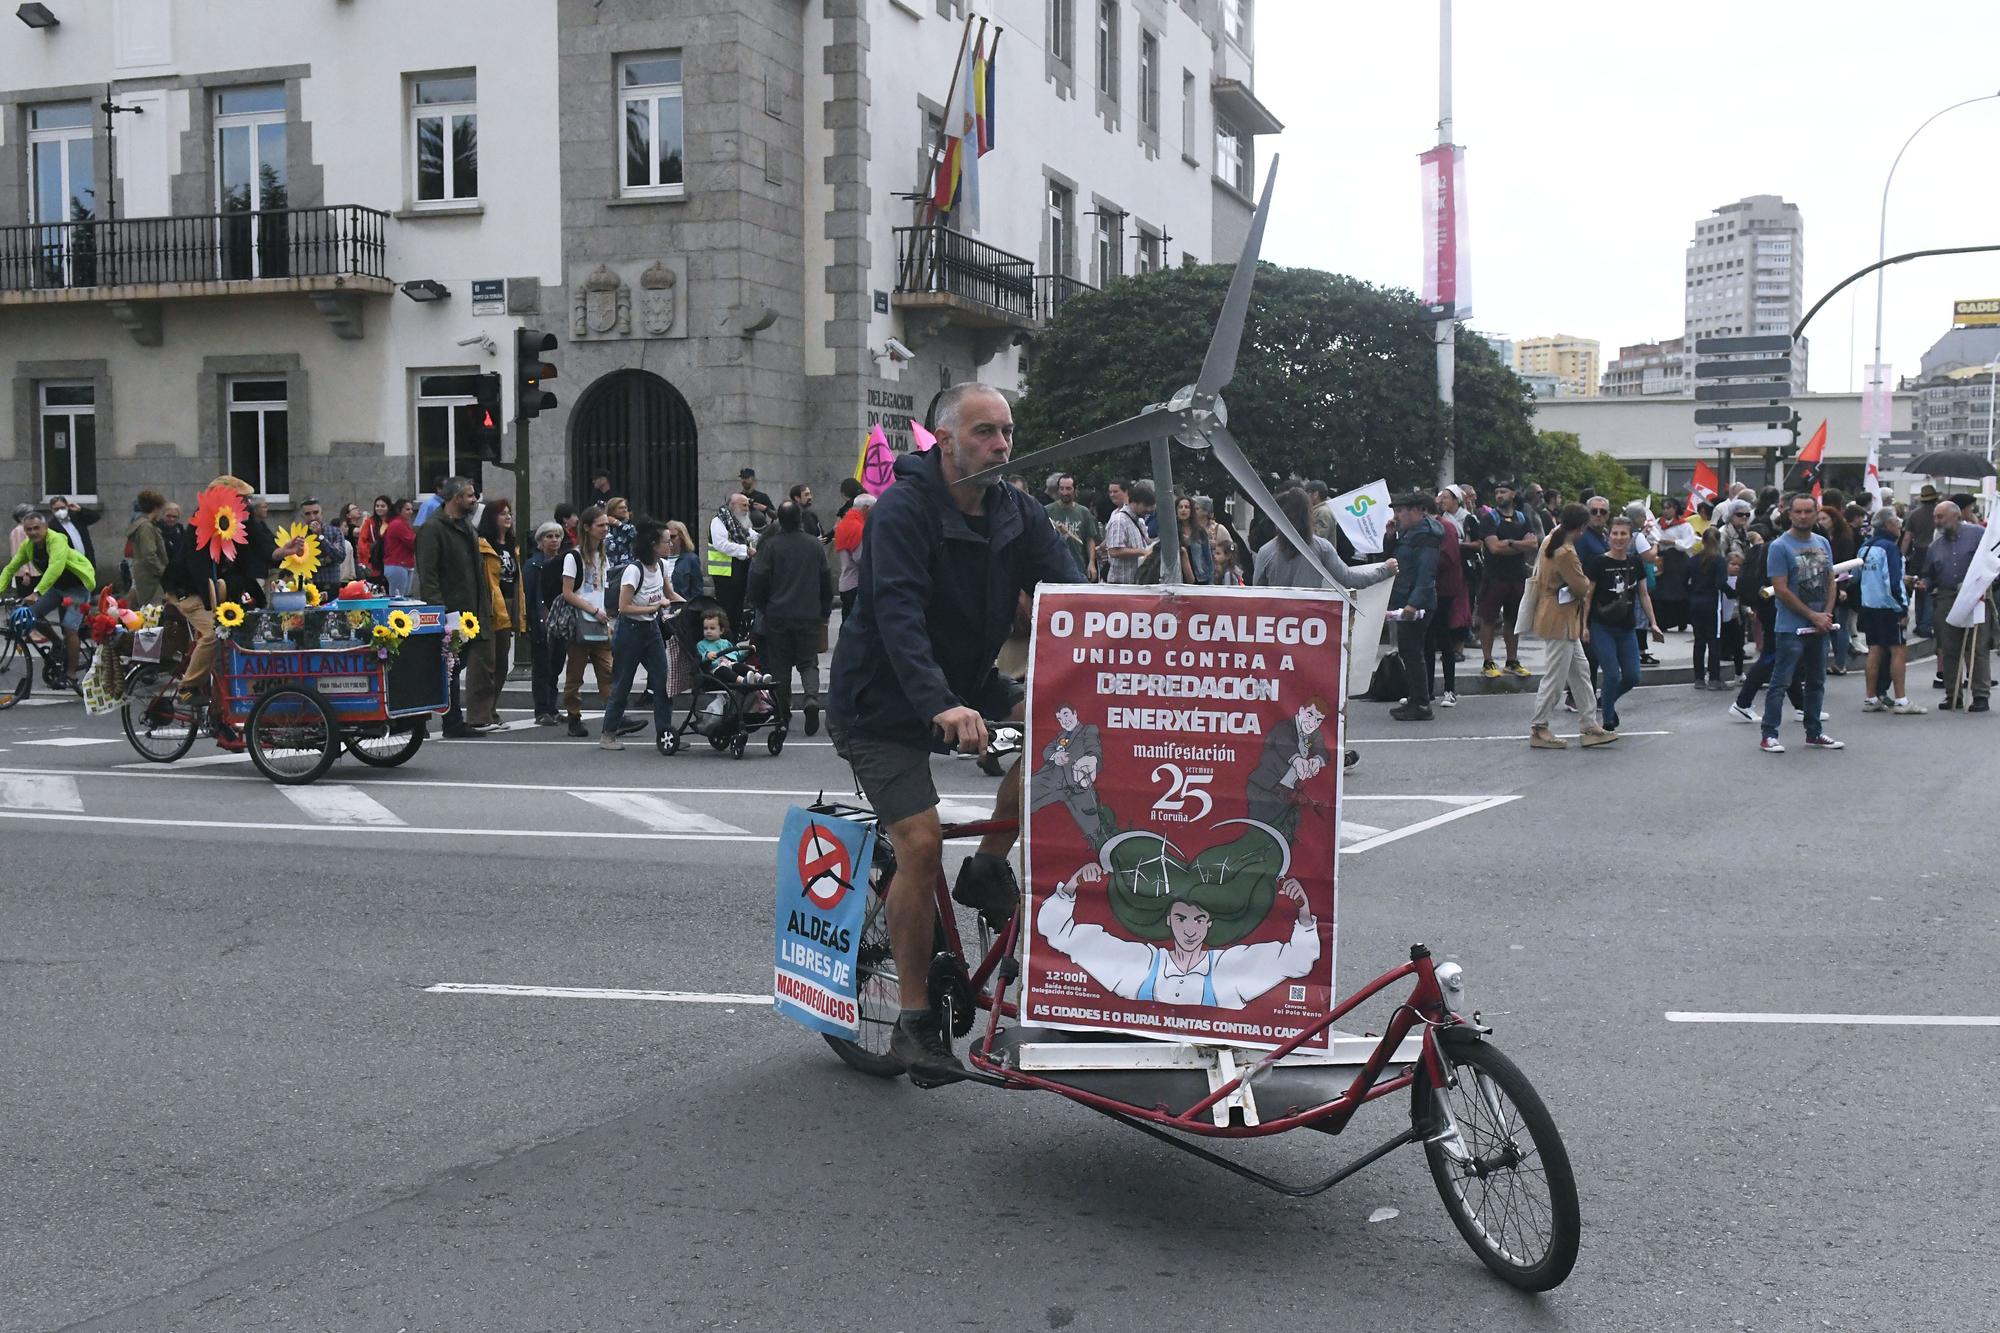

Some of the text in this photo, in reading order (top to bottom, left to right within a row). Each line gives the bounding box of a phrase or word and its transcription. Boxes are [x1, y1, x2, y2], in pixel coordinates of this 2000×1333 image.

[1957, 301, 2000, 313] GADIS
[867, 411, 916, 432] DO GOBERN
[1050, 610, 1328, 646] O POBO GALEGO
[1072, 648, 1295, 671] UNIDO CONTRA A
[1096, 671, 1280, 702] DEPREDACIÓN
[1107, 706, 1262, 735] ENERXÉTICA
[1133, 741, 1236, 762] manifestación
[1151, 763, 1214, 823] 25
[1150, 810, 1189, 822] A Coruña
[787, 909, 850, 954] ALDEAS
[781, 938, 850, 988] LIBRES DE
[1046, 971, 1088, 983] 12:00h
[777, 973, 855, 1024] MACROEÓLICOS
[1031, 987, 1065, 995] Delegación
[1075, 990, 1101, 999] Goberno
[1033, 1004, 1050, 1016] AS
[1051, 1005, 1101, 1020] CIDADES
[1102, 1010, 1111, 1021] E
[1111, 1011, 1121, 1022] O
[1123, 1012, 1162, 1026] RURAL
[1162, 1016, 1211, 1031] XUNTAS
[1212, 1021, 1261, 1036] CONTRA
[1262, 1025, 1273, 1037] O
[1302, 1010, 1322, 1018] Vento
